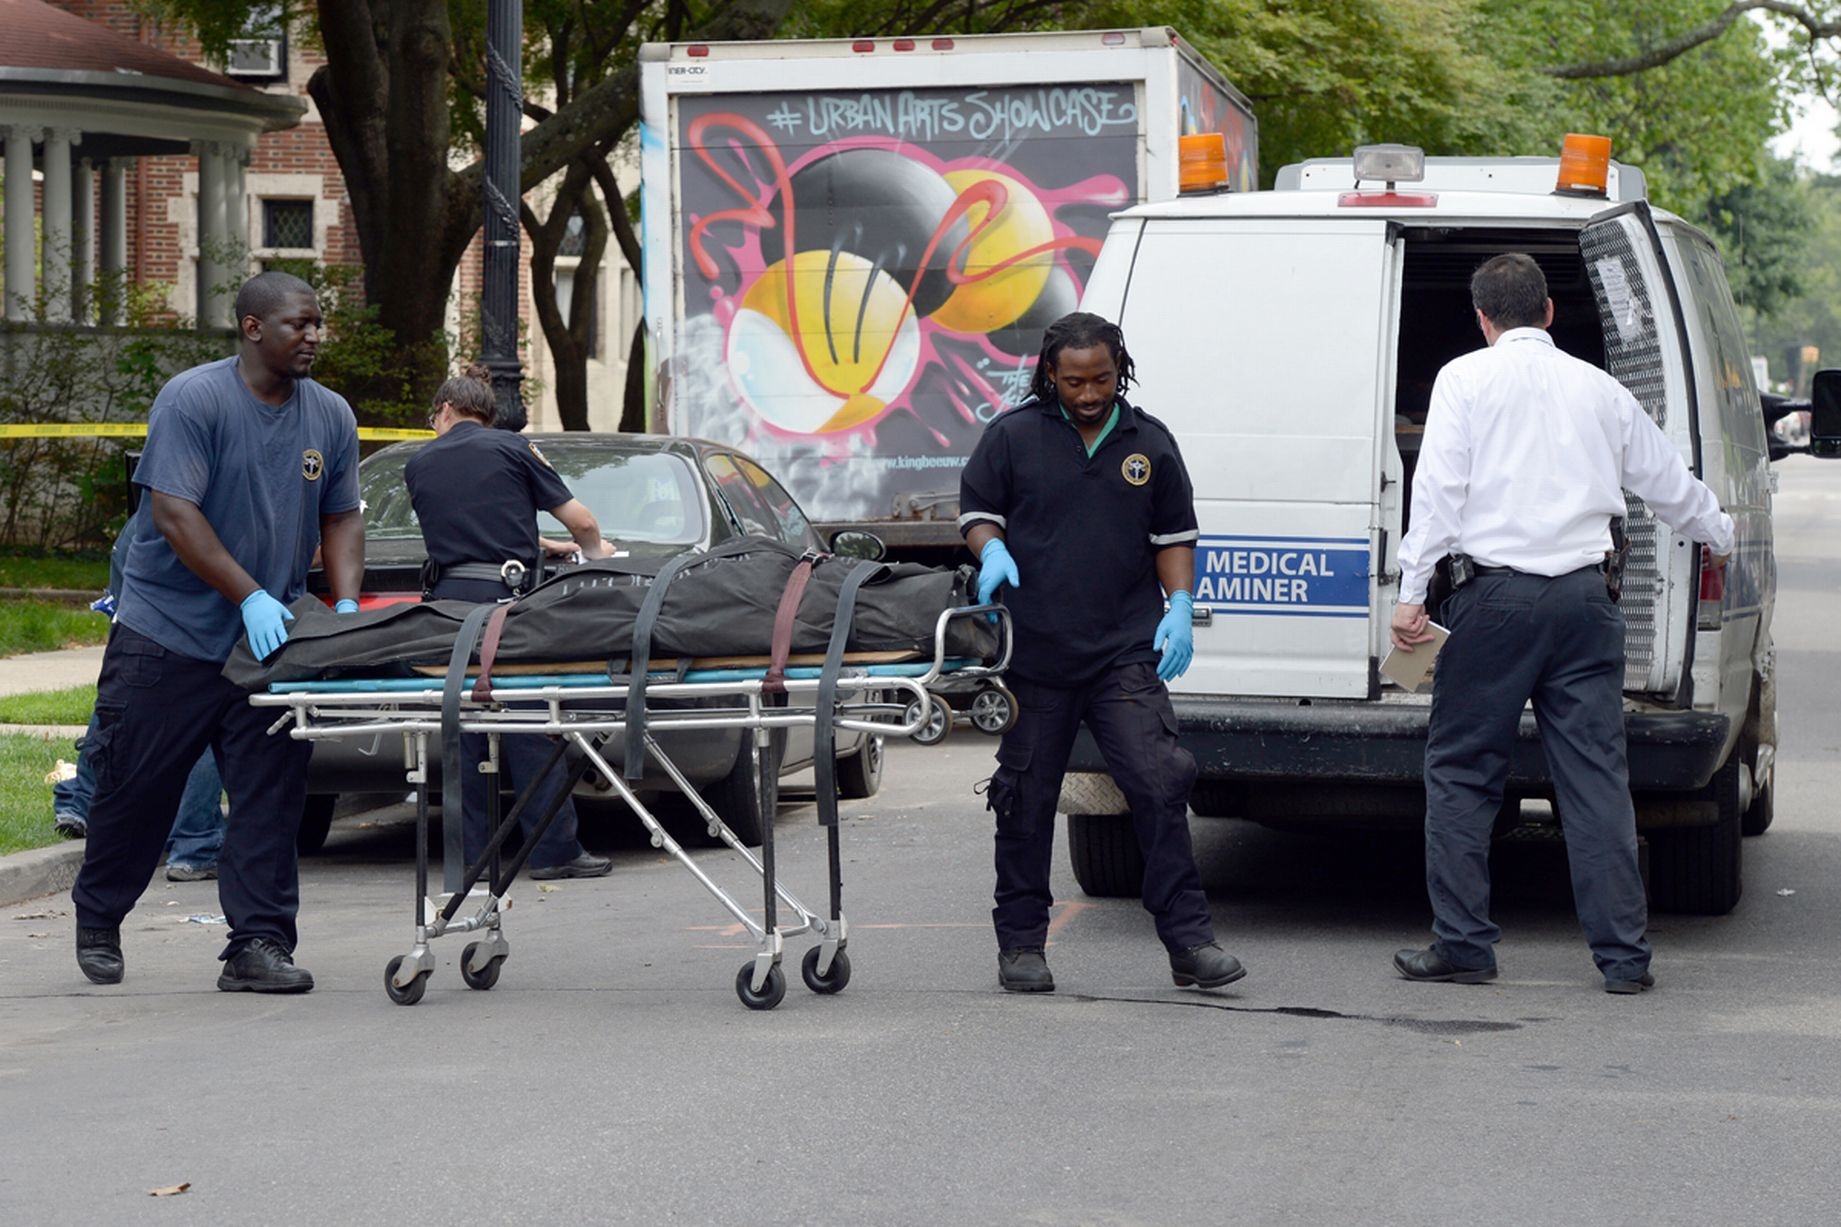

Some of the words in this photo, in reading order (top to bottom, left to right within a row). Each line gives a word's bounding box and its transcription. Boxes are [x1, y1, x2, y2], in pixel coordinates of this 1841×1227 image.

[806, 93, 895, 136] URBAN
[964, 87, 1137, 145] SHOWCASE
[1206, 551, 1334, 577] MEDICAL
[1193, 576, 1308, 602] AMINER
